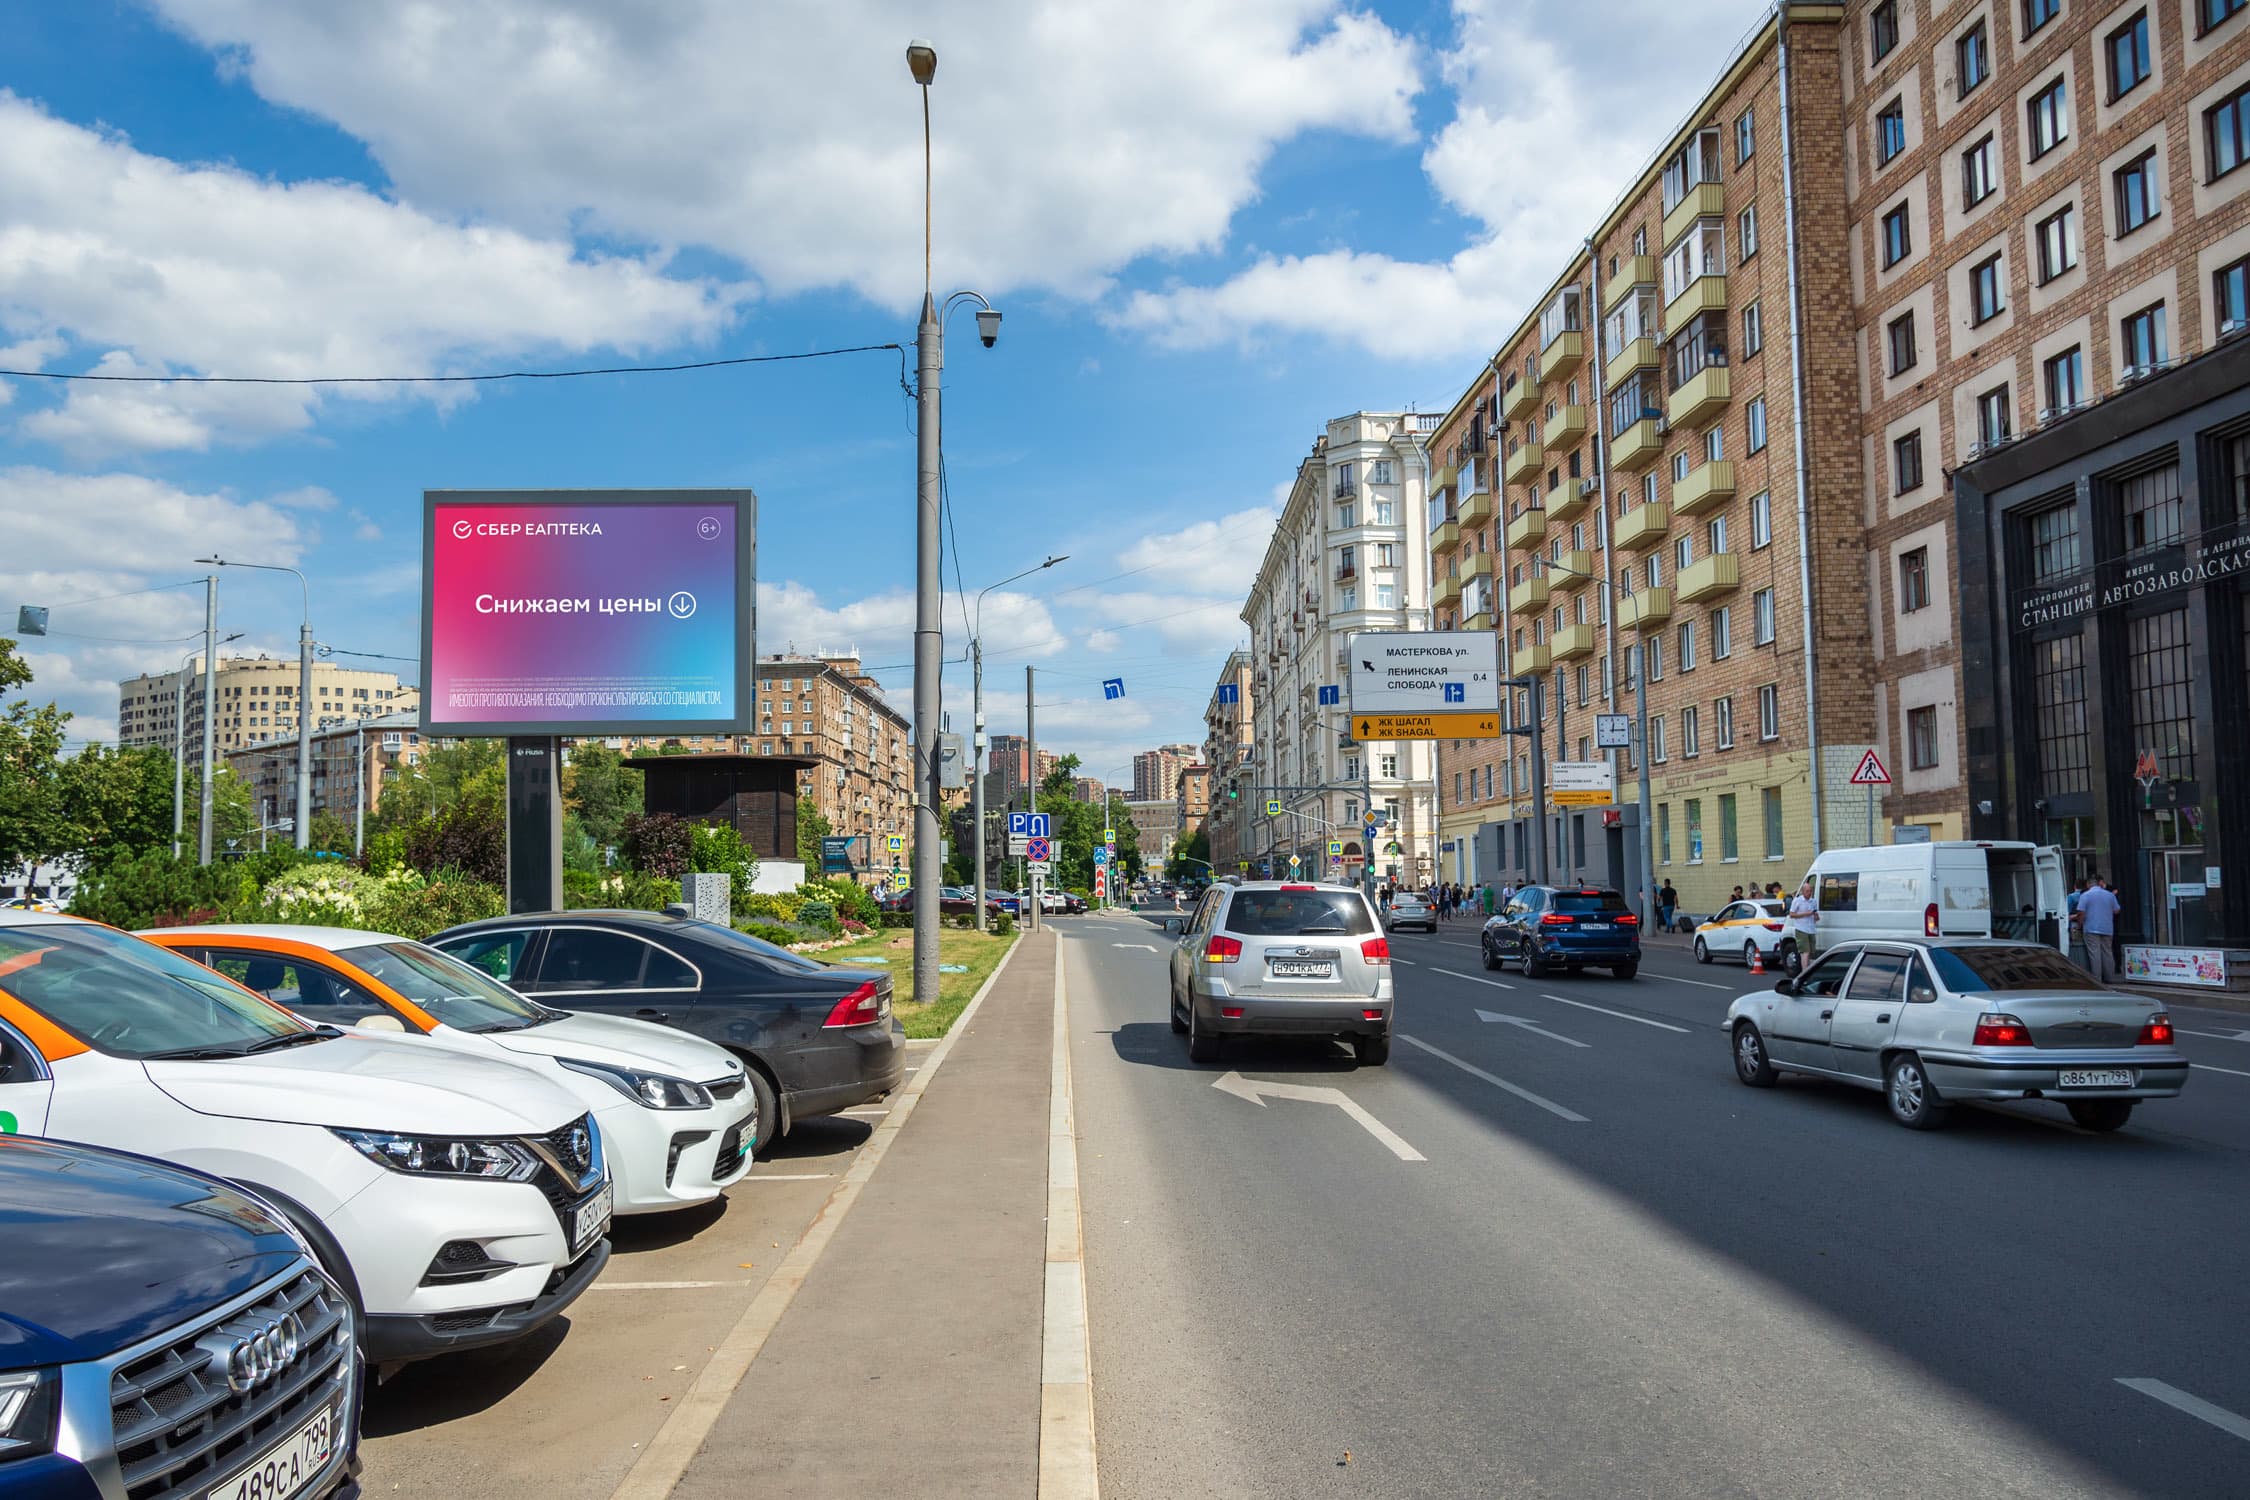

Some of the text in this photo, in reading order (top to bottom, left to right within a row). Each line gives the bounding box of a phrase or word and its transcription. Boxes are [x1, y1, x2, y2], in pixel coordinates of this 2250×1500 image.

[476, 523, 603, 536] СБЕР ЕАПТЕКА
[701, 522, 717, 534] 6+
[2125, 562, 2155, 578] ИМЕНИ
[2022, 582, 2090, 610] МЕТРОПОЛИТЕН
[475, 594, 662, 617] Снижаем цены
[2021, 594, 2094, 627] СТАНЦИЯ
[1386, 647, 1469, 658] МАСТЕРКОВА ул.
[1387, 667, 1448, 676] ЛЕНИНСКАЯ
[1473, 673, 1487, 682] 0.4
[1387, 681, 1436, 690] СЛОБОДА
[1378, 717, 1431, 726] ЖК ШАГАЛ
[1480, 722, 1493, 730] 4.6
[1378, 728, 1436, 737] ЖК SHAGAL
[304, 1416, 327, 1463] 799
[308, 1452, 321, 1471] RUS
